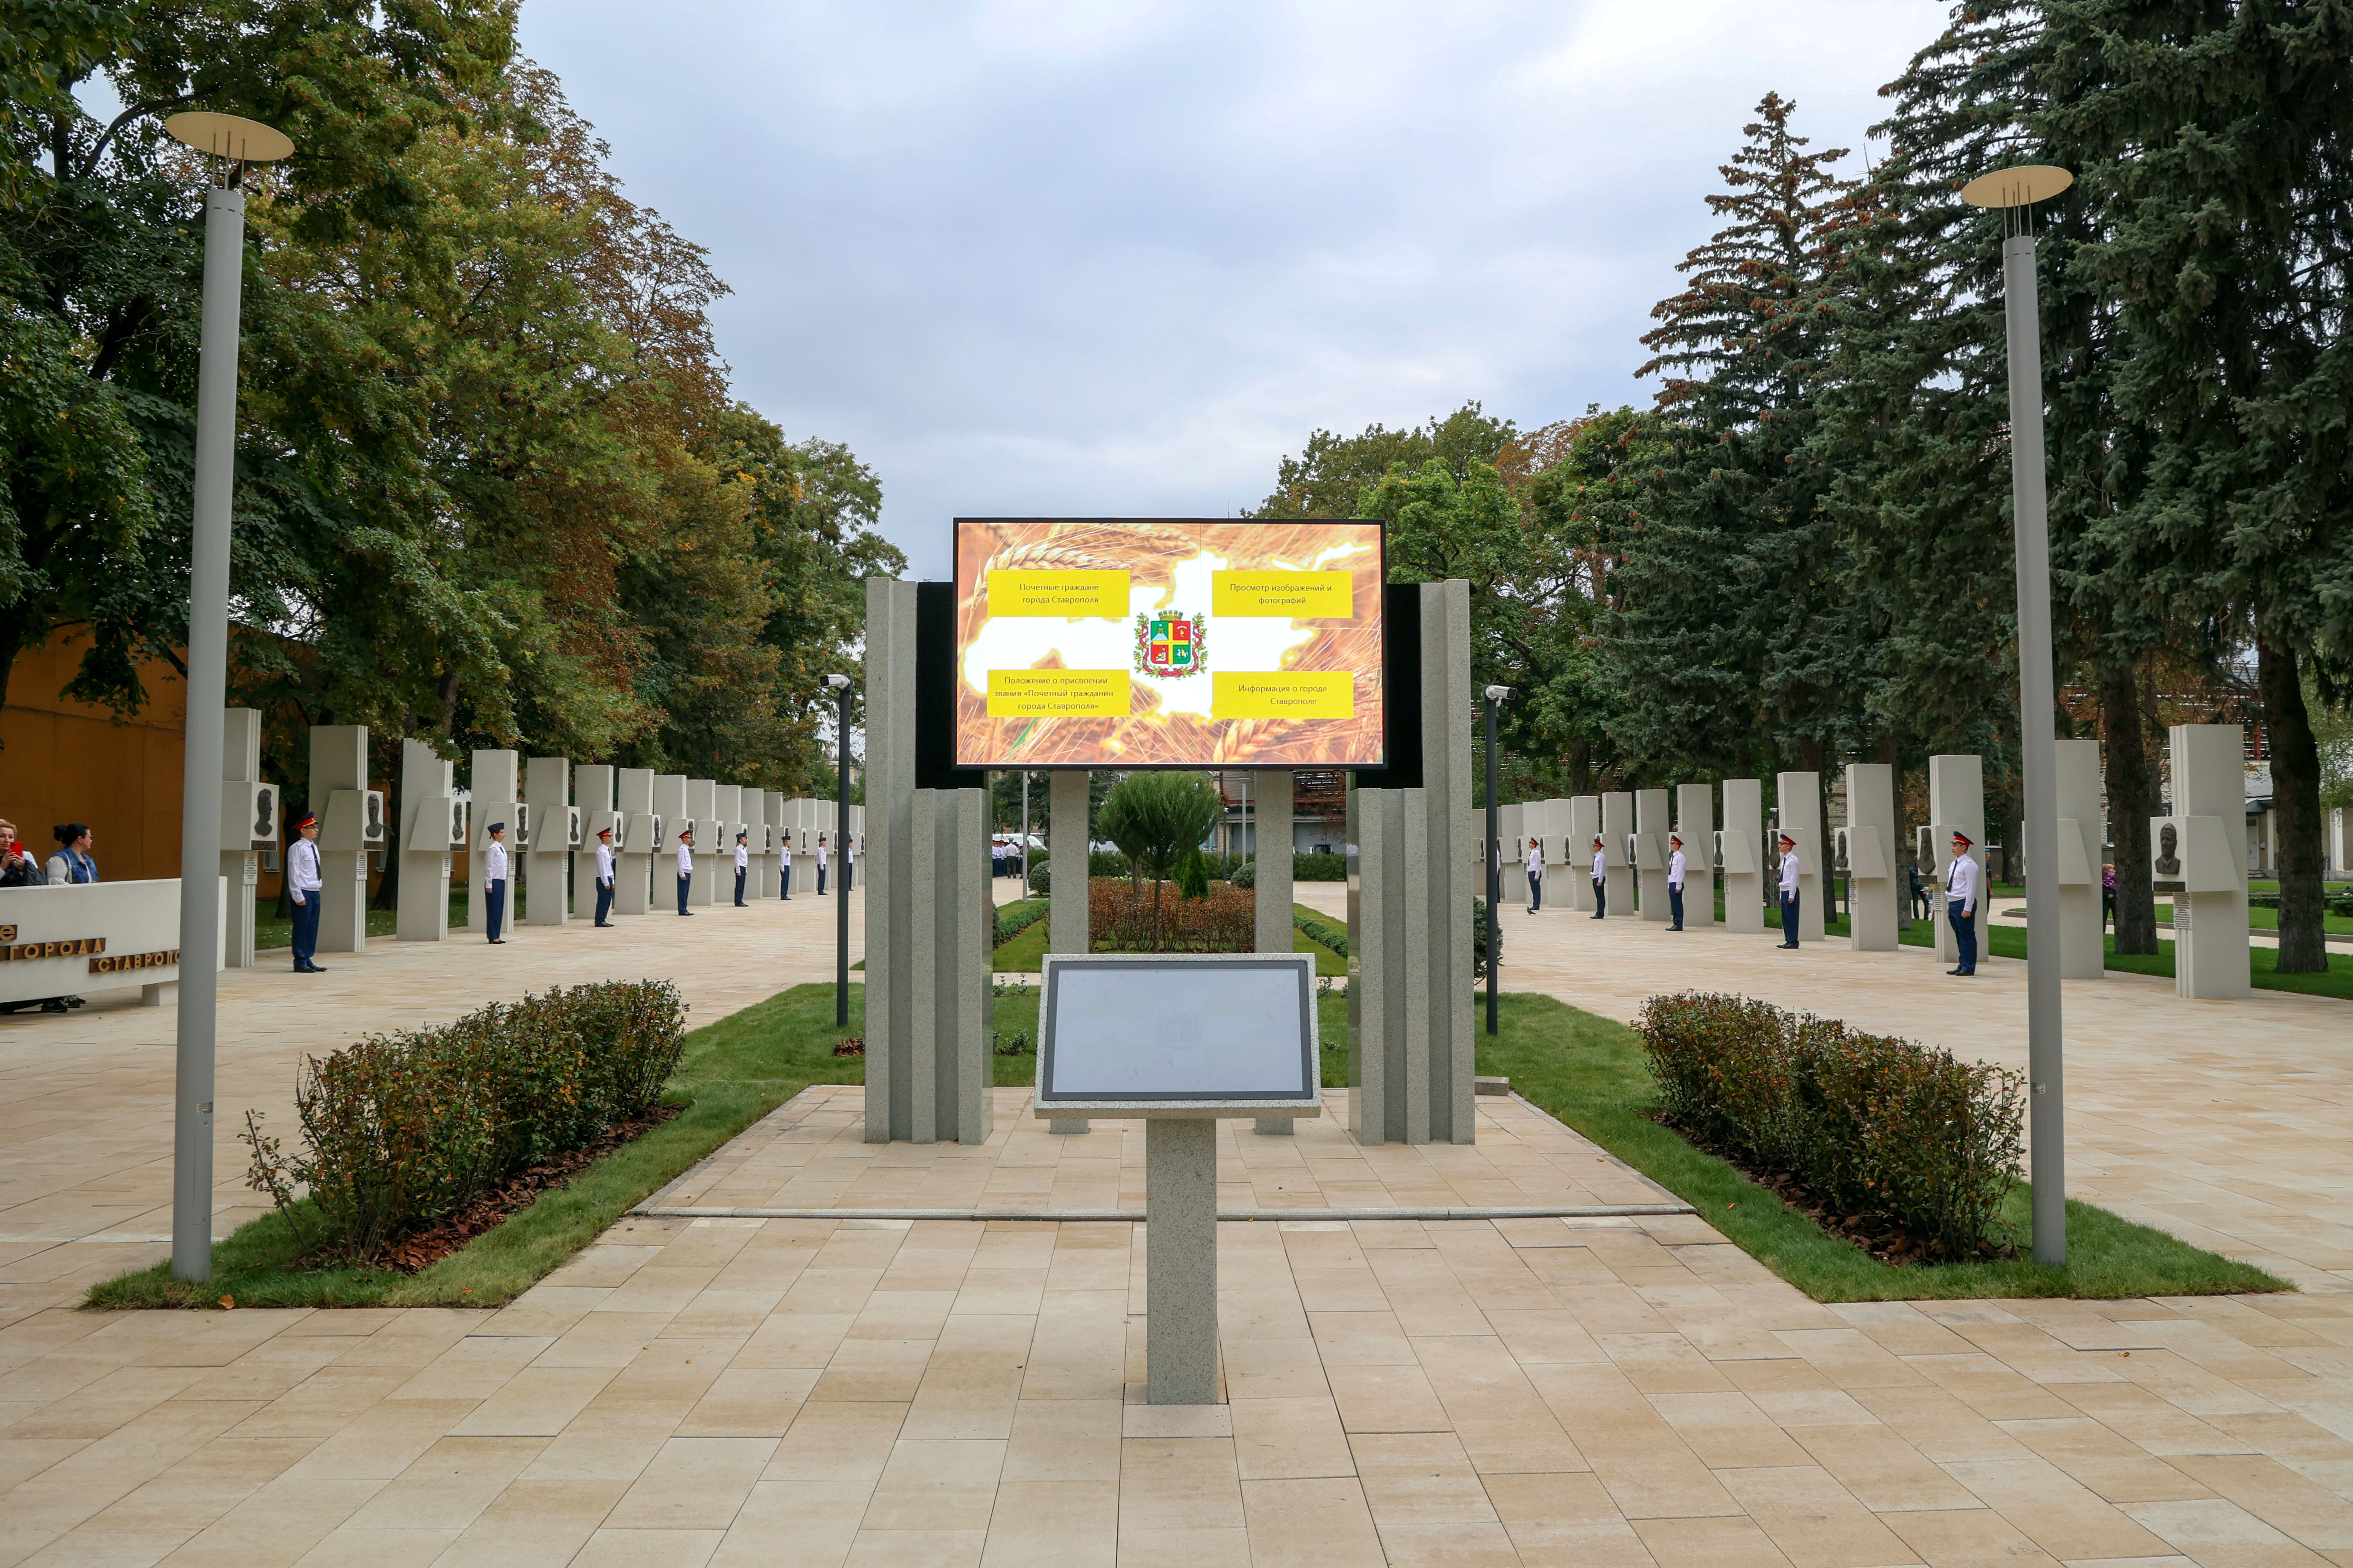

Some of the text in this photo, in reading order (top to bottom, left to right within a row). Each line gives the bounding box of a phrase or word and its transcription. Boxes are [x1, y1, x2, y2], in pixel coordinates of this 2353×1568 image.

[1230, 584, 1269, 592] Просмотр
[1272, 584, 1325, 592] изображений
[1052, 596, 1098, 605] Ставрополя
[1259, 597, 1306, 605] фотографий
[1239, 685, 1290, 694] Информация
[1270, 697, 1317, 706] Ставрополе
[1048, 702, 1099, 711] Ставрополя»
[10, 938, 102, 961] ГОРОДА
[98, 949, 180, 972] СТАВРОПО
